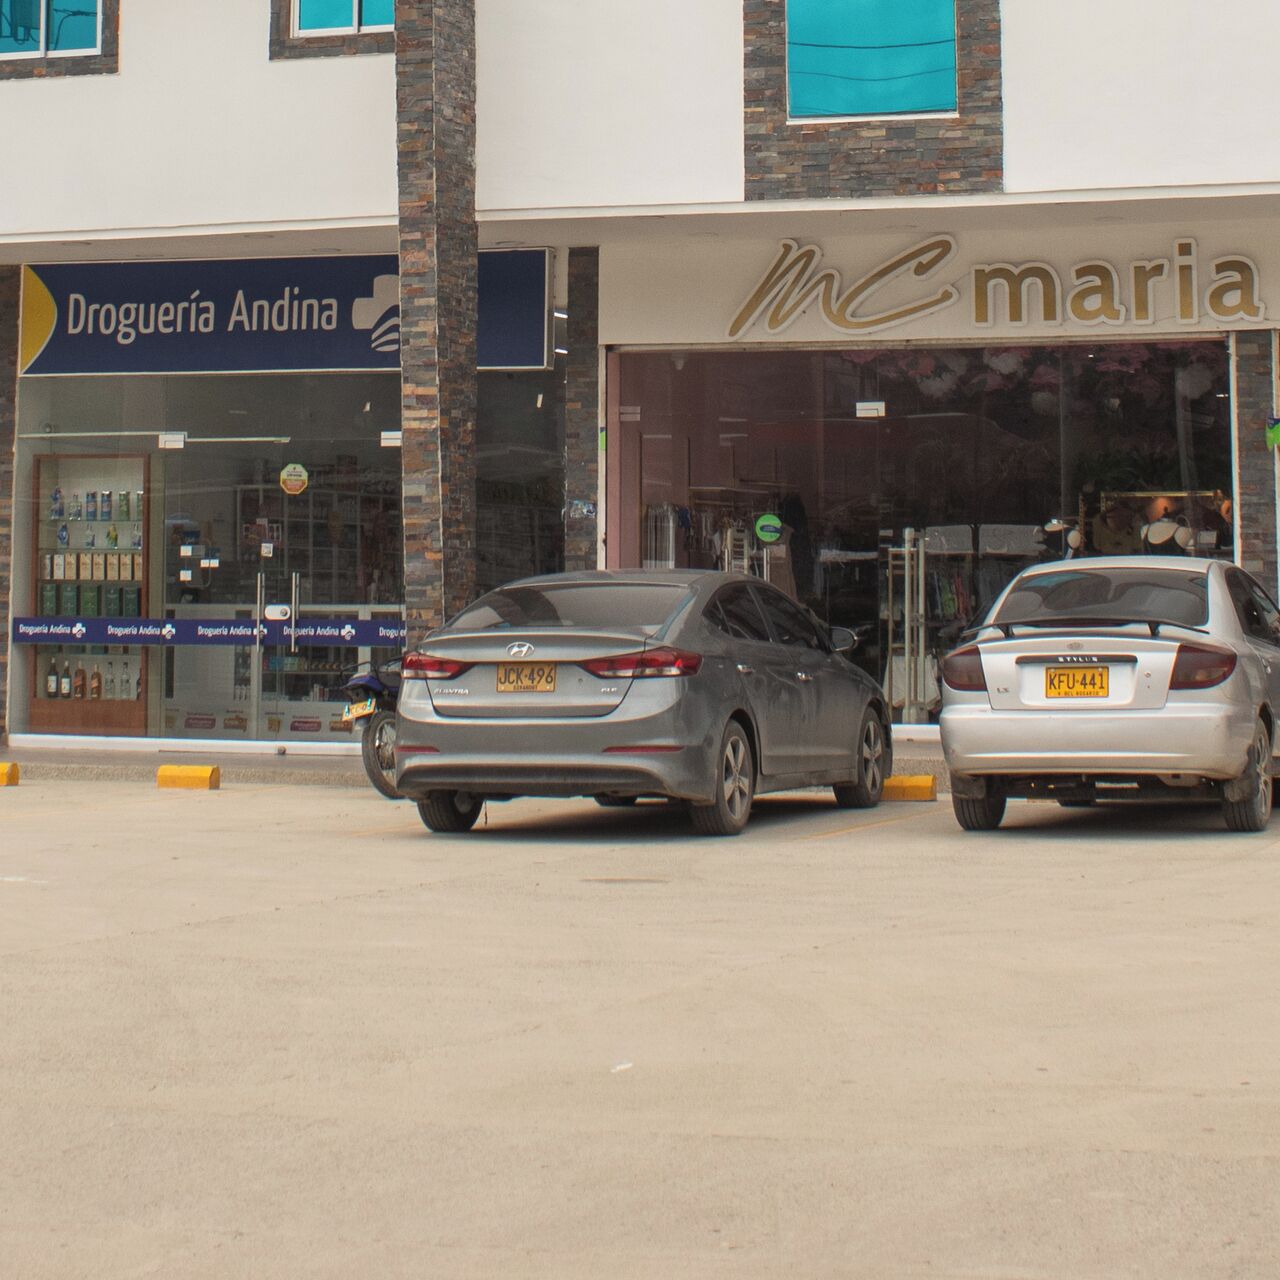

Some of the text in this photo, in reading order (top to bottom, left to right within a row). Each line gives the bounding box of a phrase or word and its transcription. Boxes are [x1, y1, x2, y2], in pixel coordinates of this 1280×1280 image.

[972, 238, 1264, 325] maria
[67, 286, 338, 345] Droguería Andina
[19, 624, 71, 636] Droguería Andina
[107, 625, 161, 637] Droguería Andina
[198, 625, 252, 637] Droguería Andina
[316, 626, 339, 636] Andina
